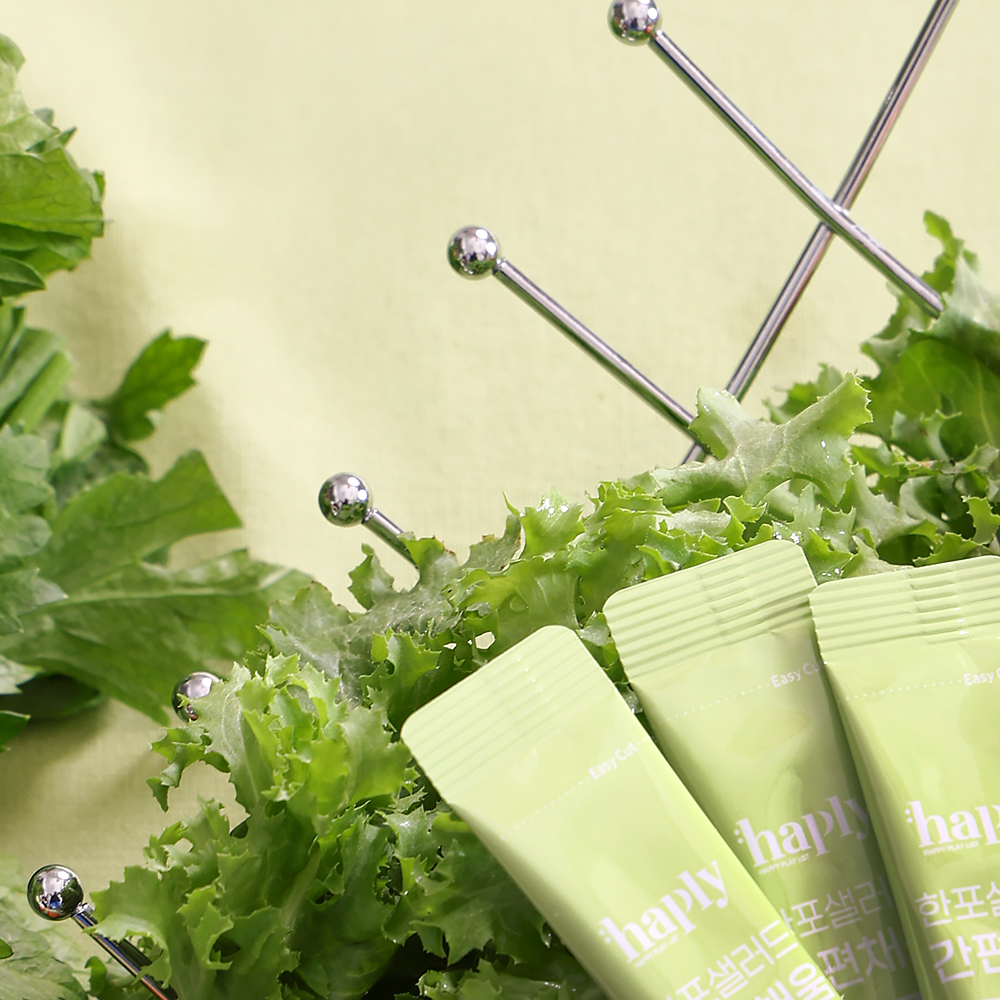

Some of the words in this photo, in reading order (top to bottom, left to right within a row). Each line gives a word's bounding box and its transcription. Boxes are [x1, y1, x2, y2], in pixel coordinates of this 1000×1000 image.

[770, 668, 801, 688] Easy
[964, 670, 994, 686] Easy
[588, 755, 618, 780] Easy
[615, 741, 638, 761] Cut
[781, 875, 894, 938] 포샐러
